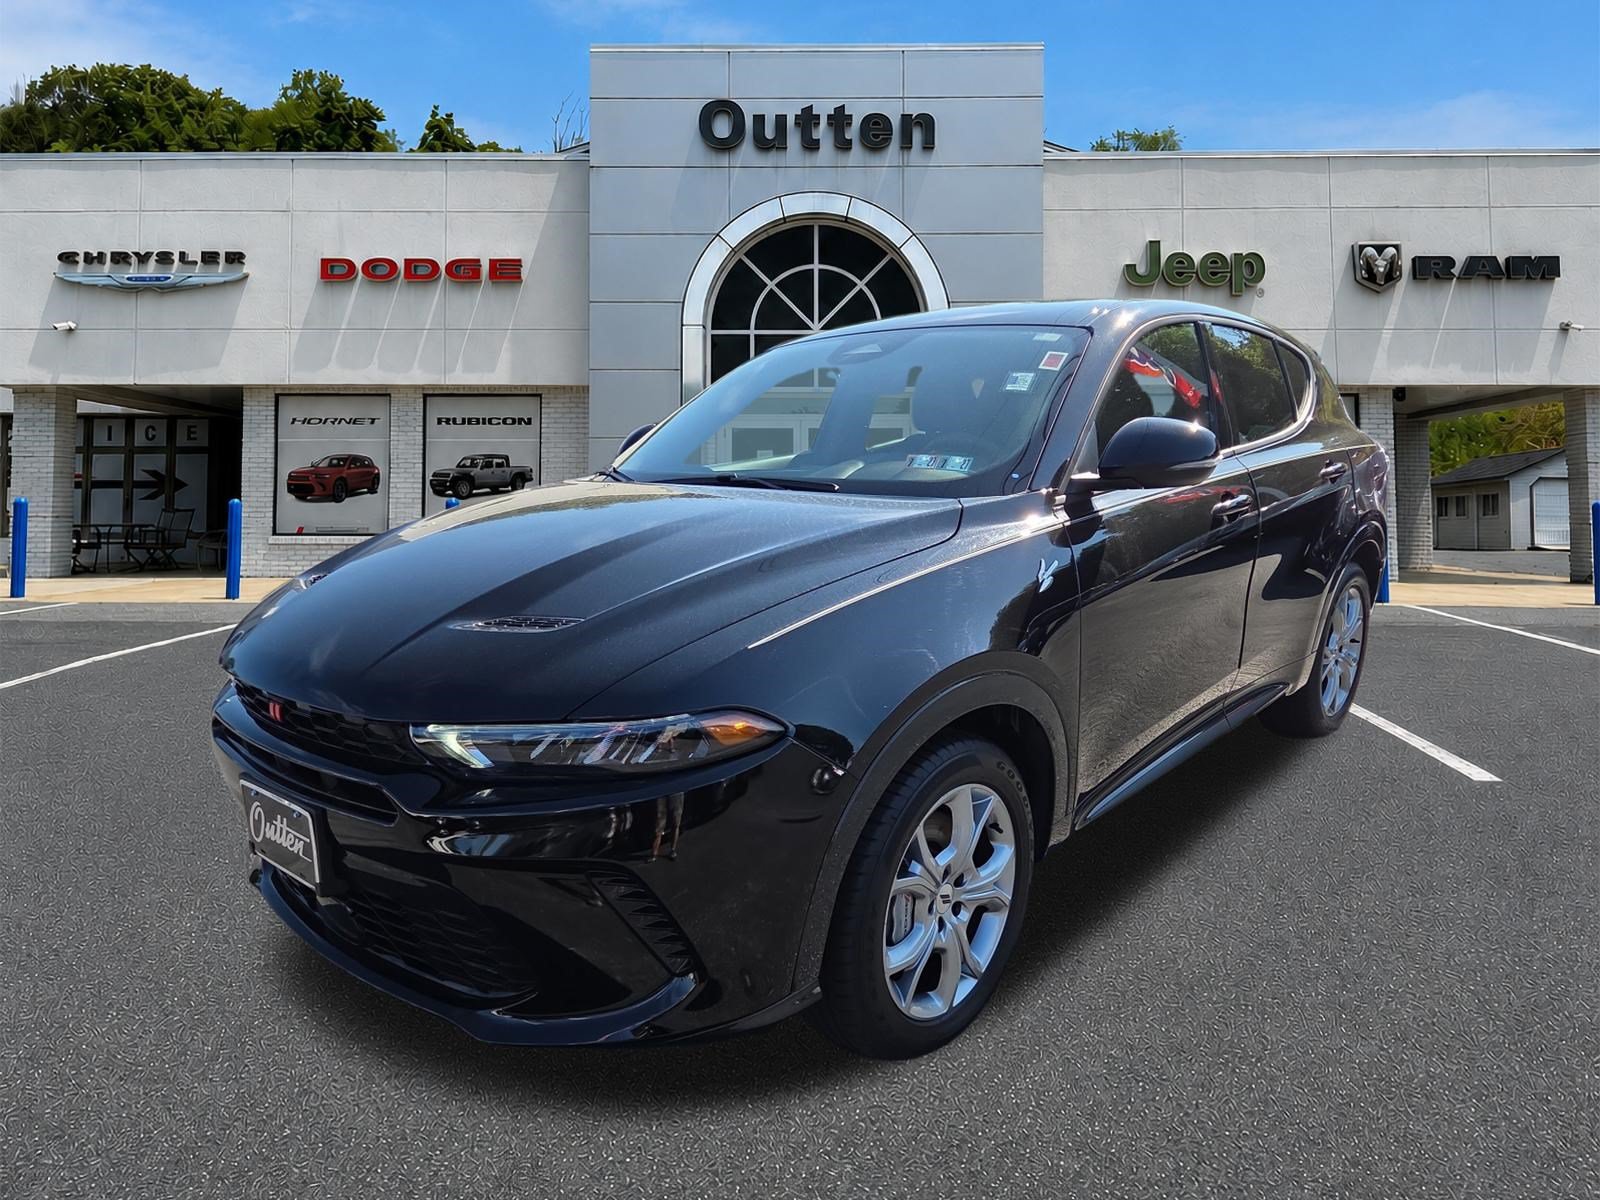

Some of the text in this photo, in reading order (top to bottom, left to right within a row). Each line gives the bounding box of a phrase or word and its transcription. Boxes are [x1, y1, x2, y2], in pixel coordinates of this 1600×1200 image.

[699, 99, 936, 150] Outten
[57, 251, 247, 266] CHRYSLER
[320, 258, 523, 282] DODGE
[1123, 240, 1266, 297] Jeep
[1411, 255, 1561, 280] RAM
[290, 417, 380, 426] HORNET
[436, 416, 533, 426] RUBICON
[249, 801, 312, 863] Outten
